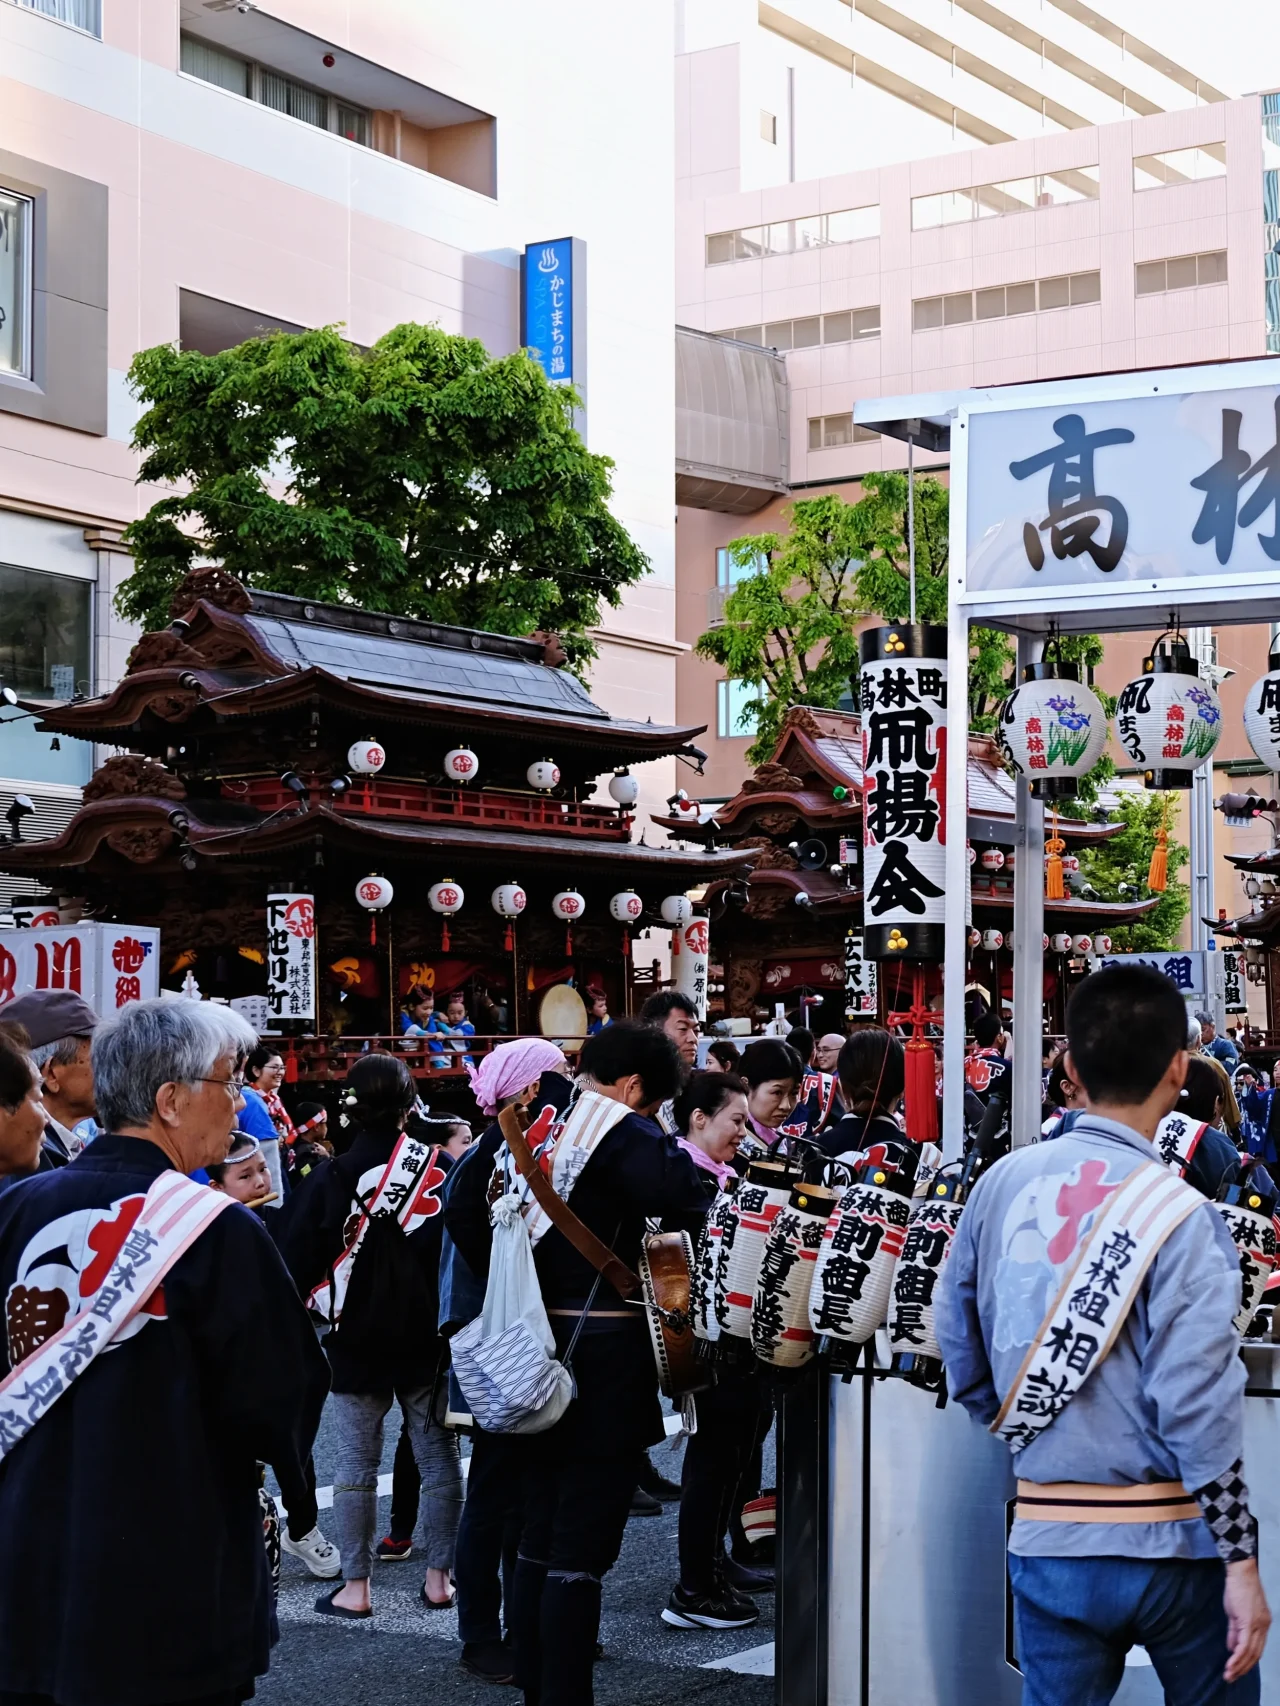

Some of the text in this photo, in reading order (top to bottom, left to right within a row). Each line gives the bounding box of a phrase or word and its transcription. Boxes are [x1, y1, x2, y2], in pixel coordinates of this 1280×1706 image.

[550, 275, 565, 374] かじまちの湯
[1115, 677, 1154, 763] 凧まつり
[289, 966, 301, 1015] 株式会社
[812, 1214, 885, 1336] 副組長
[889, 1226, 950, 1345] 副組長
